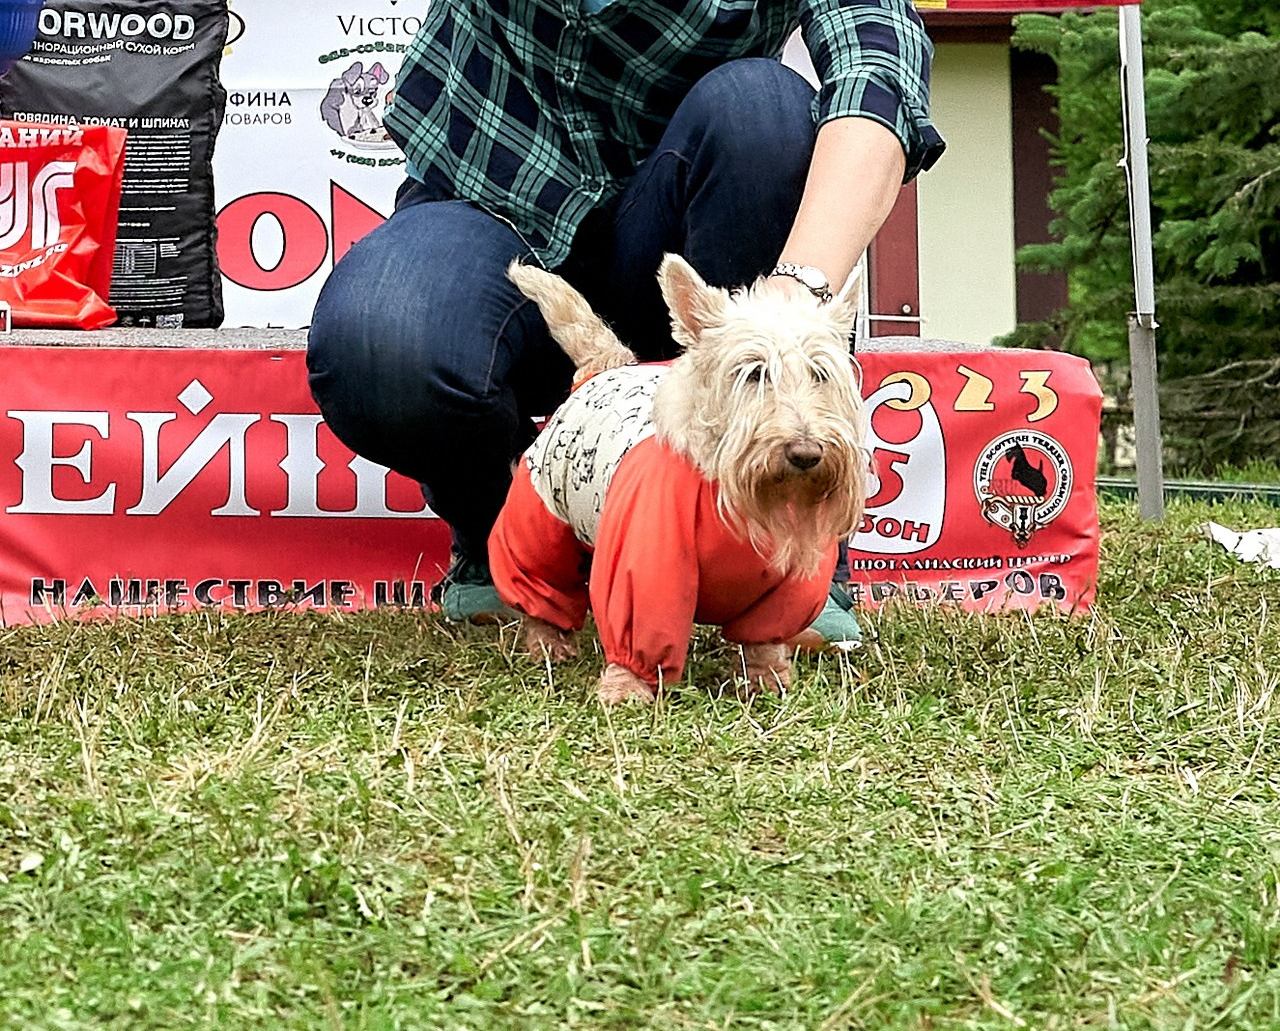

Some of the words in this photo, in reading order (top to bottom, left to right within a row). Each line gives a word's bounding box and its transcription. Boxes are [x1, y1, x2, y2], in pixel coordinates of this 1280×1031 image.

[38, 8, 195, 40] ORWOOD
[126, 41, 162, 55] СУХОЙ
[83, 116, 127, 127] ТОМАТ
[130, 118, 138, 128] И
[141, 118, 190, 129] ШПИНАТ
